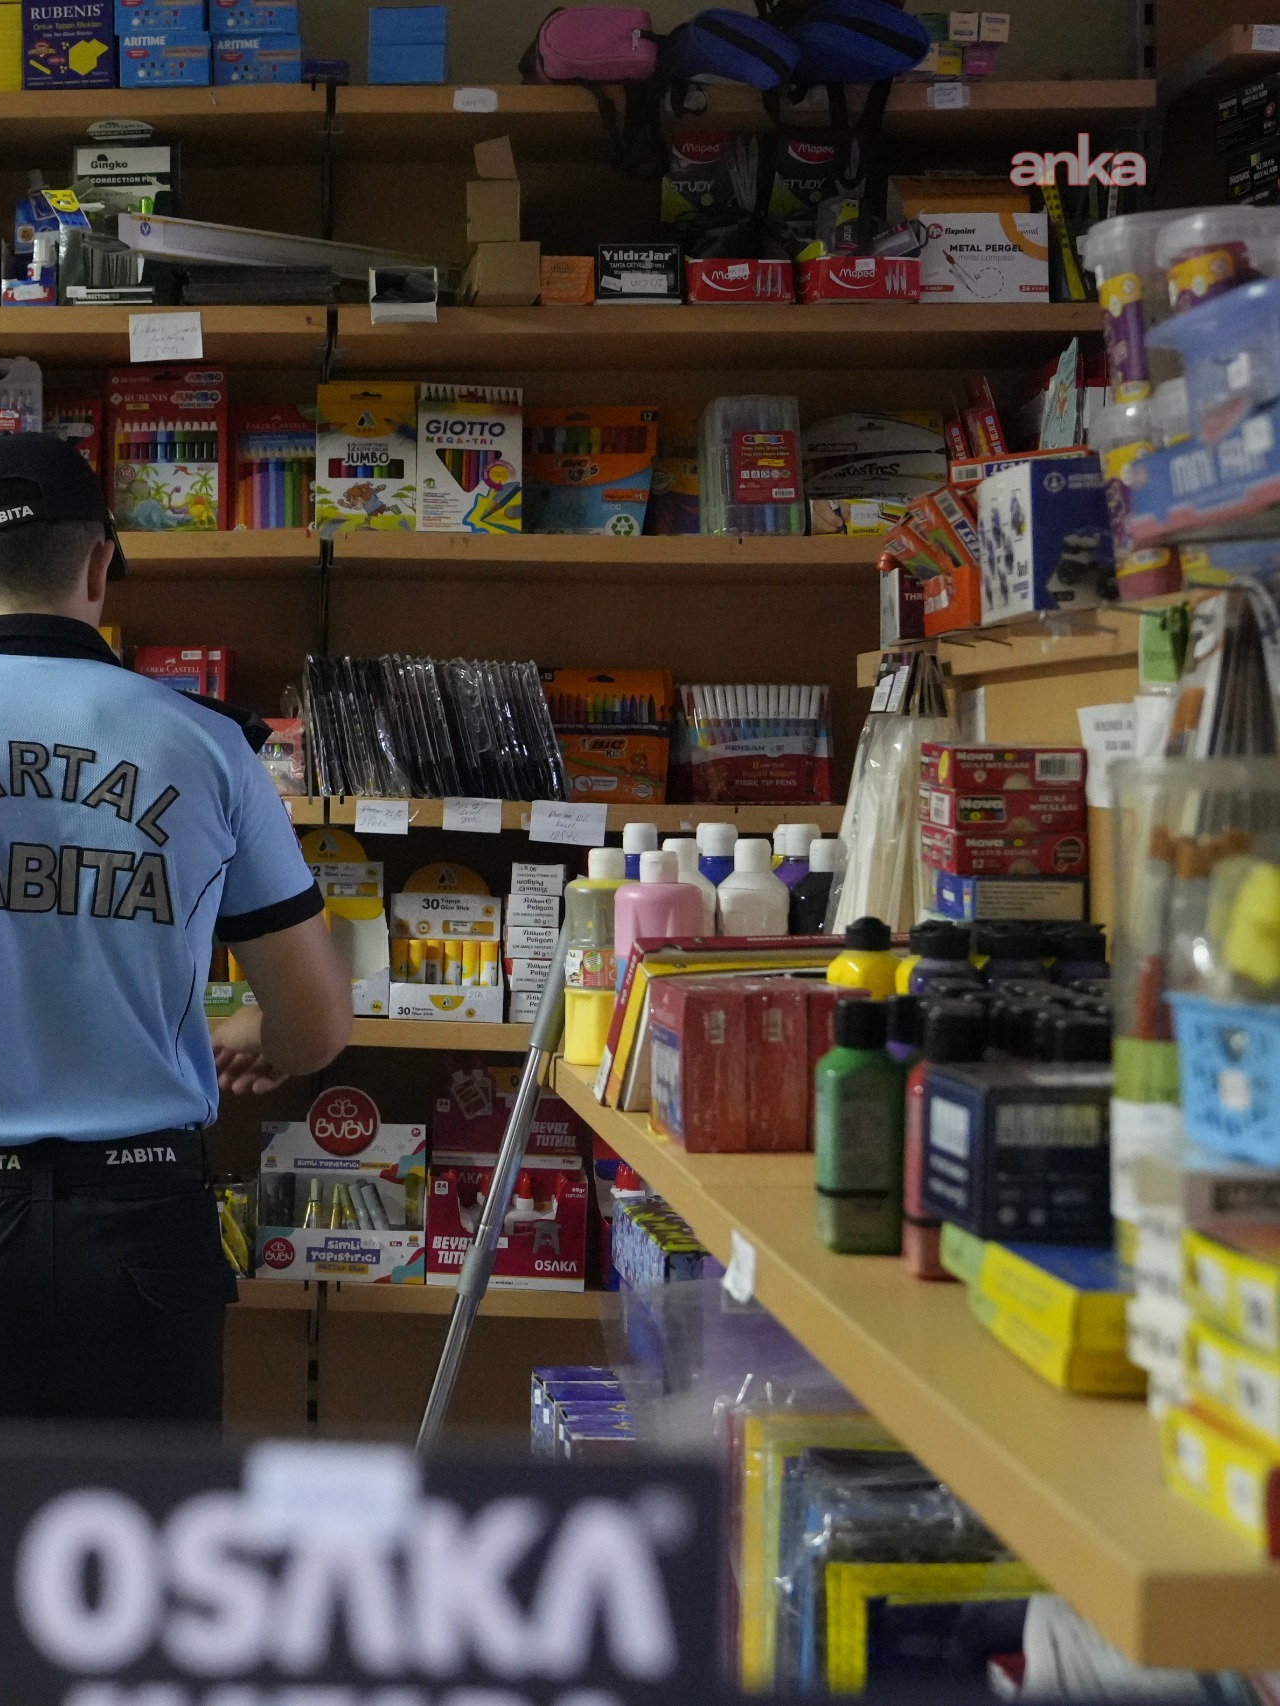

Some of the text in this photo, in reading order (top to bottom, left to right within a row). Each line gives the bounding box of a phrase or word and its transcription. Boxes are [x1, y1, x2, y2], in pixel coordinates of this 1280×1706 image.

[30, 4, 101, 19] RUBENIS
[124, 36, 166, 46] ARITIME
[217, 39, 259, 49] ARITIME
[91, 160, 128, 170] Gingko
[91, 176, 138, 184] CORRECTION
[670, 180, 715, 193] STUDY
[945, 226, 976, 236] fixpoint
[950, 244, 1024, 252] METAL PERGEL
[602, 250, 672, 260] Yıldızlar
[125, 394, 168, 402] RUBENIS
[642, 412, 654, 421] 12
[426, 418, 506, 437] GIOTTO
[426, 436, 494, 446] MEGA-TRI
[347, 442, 357, 451] 12
[344, 452, 390, 464] JUMBO
[141, 664, 201, 674] FABER-CASTELL
[422, 898, 440, 910] 30
[522, 896, 546, 905] Pelikan
[526, 904, 554, 912] Peligom
[522, 928, 544, 938] Pelikan
[526, 936, 554, 945] Peligom
[398, 1006, 410, 1016] 30
[314, 1118, 374, 1140] BUBU
[536, 1134, 577, 1148] TUTKAL
[105, 1146, 177, 1166] ZABITA
[264, 1250, 294, 1260] BUBU
[534, 1260, 578, 1272] OSAKA
[14, 1486, 678, 1679] OSAKA
